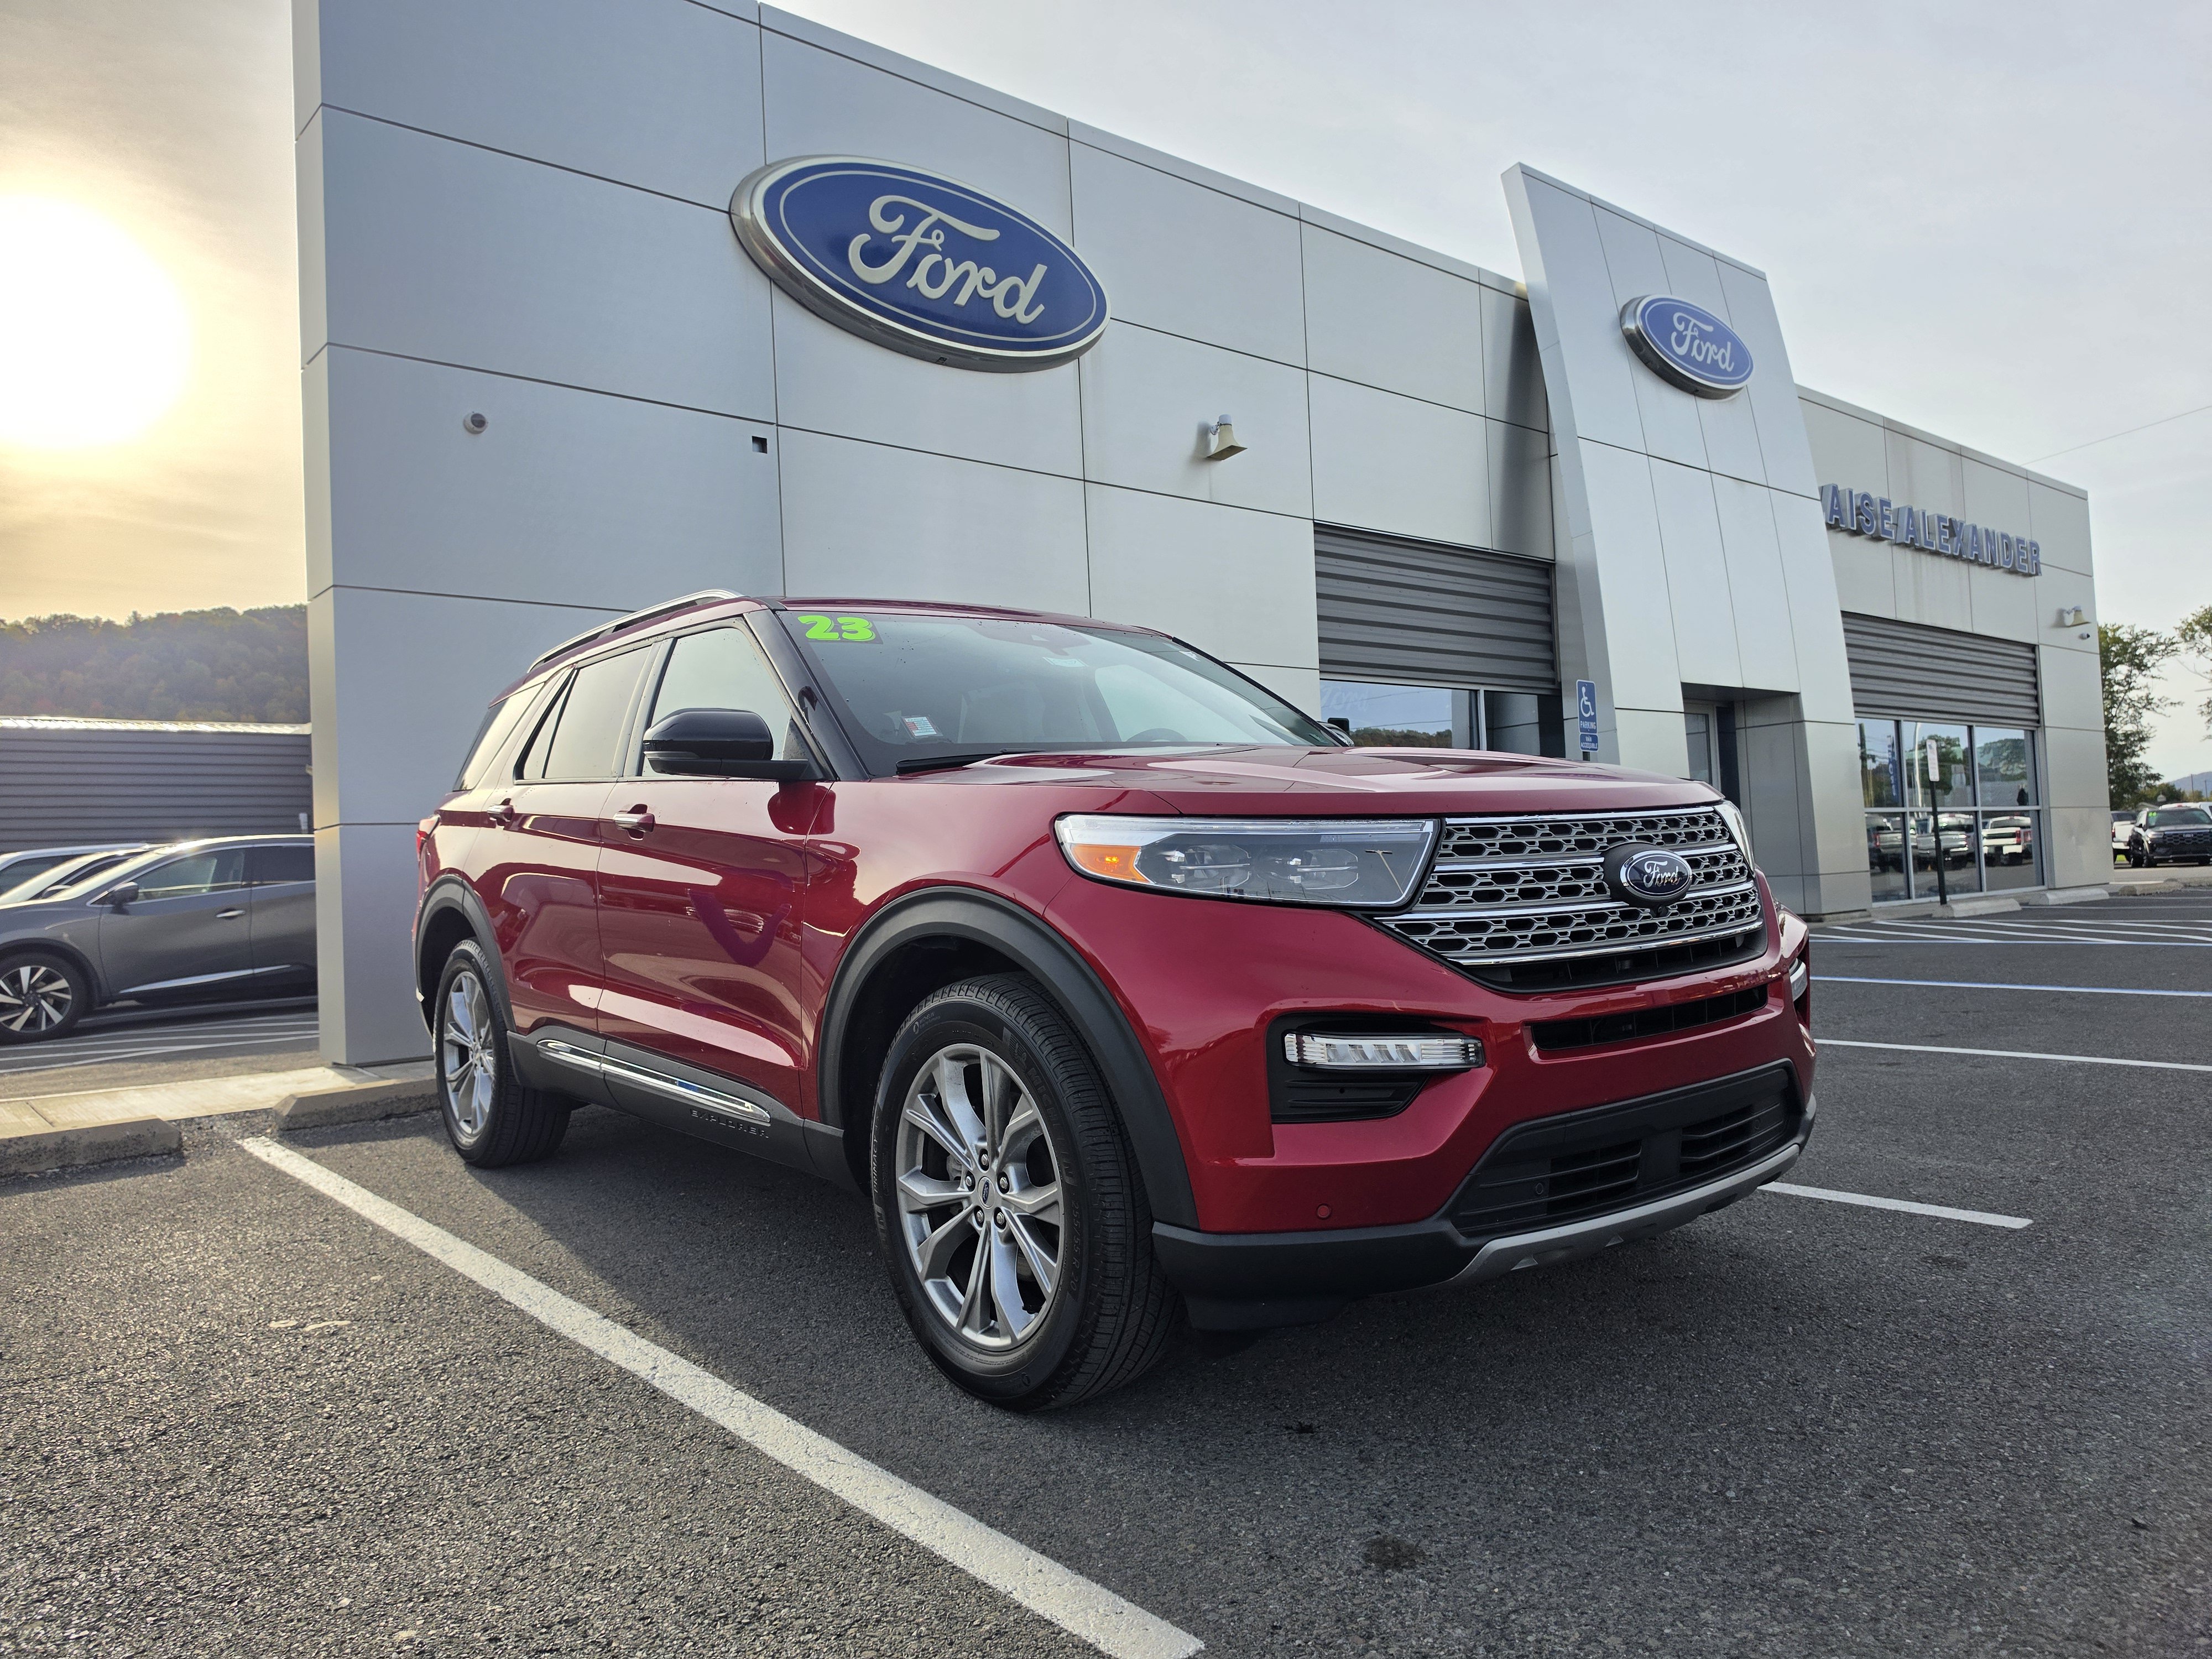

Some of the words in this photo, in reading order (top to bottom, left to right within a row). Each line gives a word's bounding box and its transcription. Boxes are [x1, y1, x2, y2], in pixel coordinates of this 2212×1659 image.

[848, 195, 1048, 325] Ford
[1671, 312, 1734, 372] Ford
[1904, 504, 2042, 576] ALEXANDER
[797, 615, 876, 641] 23
[1580, 721, 1596, 729] PARKING
[1643, 860, 1681, 888] Ford
